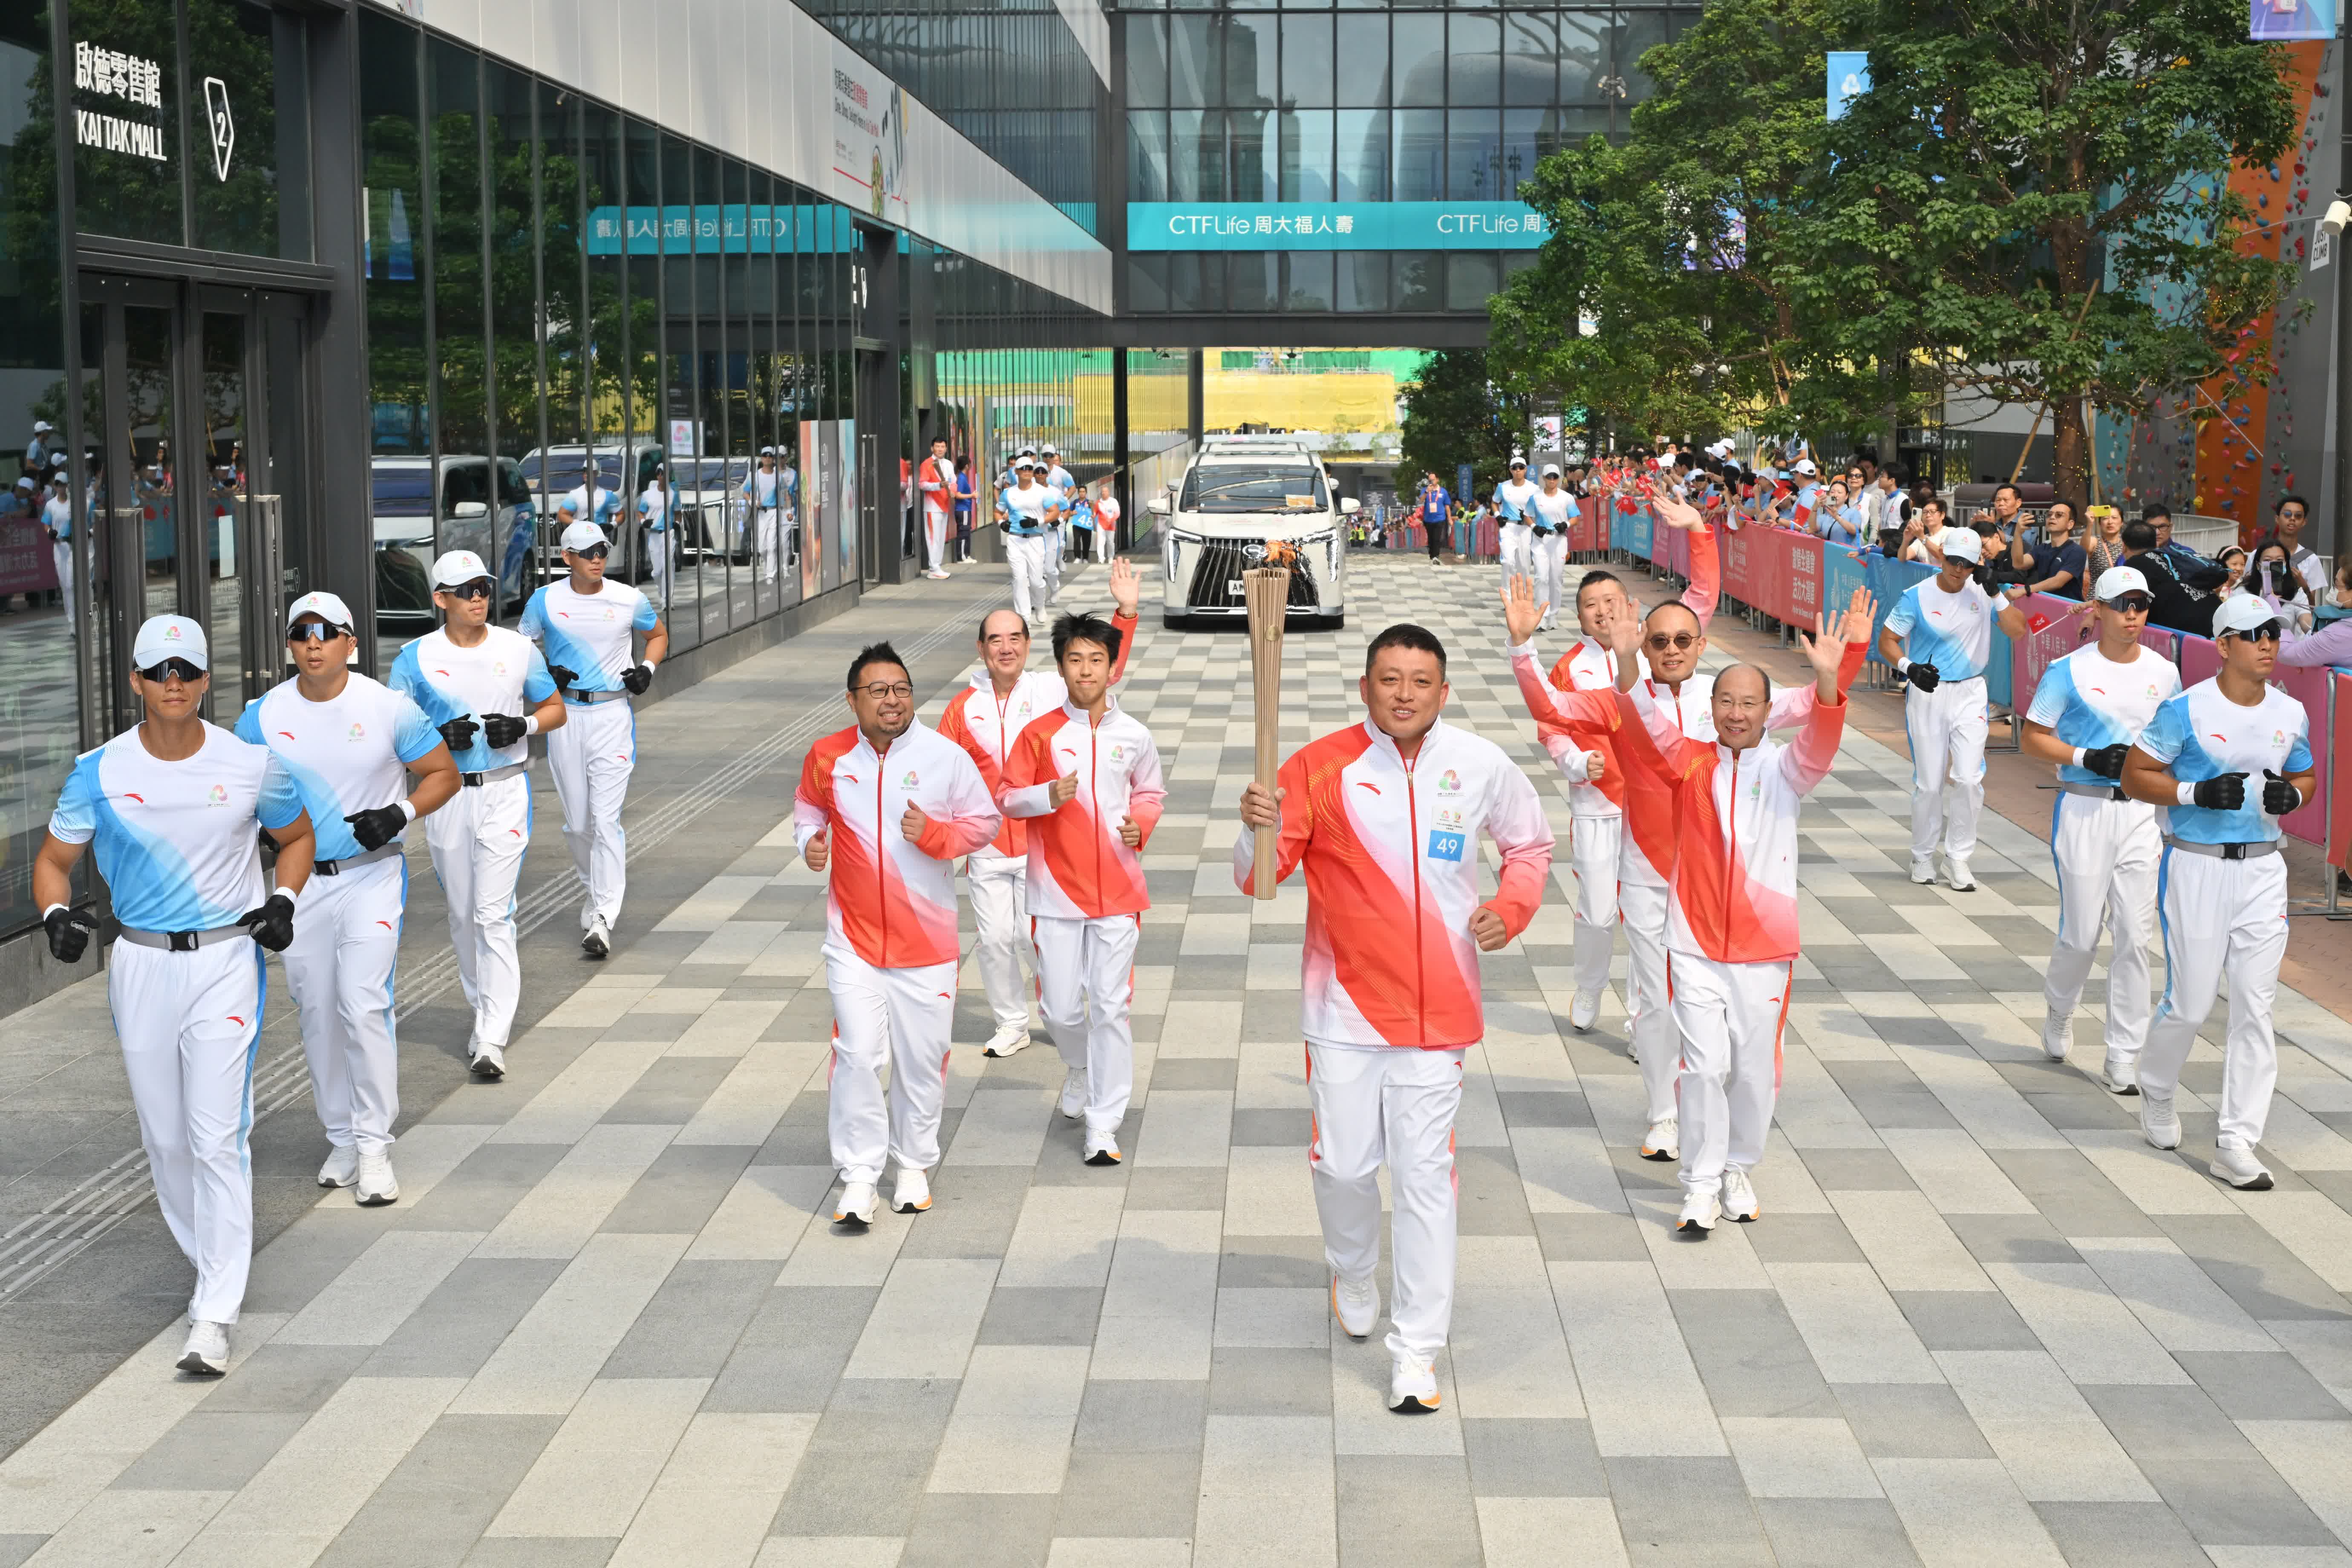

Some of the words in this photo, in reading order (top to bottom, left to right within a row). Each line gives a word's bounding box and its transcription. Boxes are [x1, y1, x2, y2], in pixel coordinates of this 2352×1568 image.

[76, 41, 161, 109] 啟德零售館
[77, 110, 102, 147] KAI
[102, 115, 131, 153] TAK
[130, 122, 167, 161] MALL
[216, 112, 227, 147] 2
[1169, 215, 1250, 234] CTFLife
[1254, 215, 1353, 234] 周大福人壽
[1437, 214, 1518, 233] CTFLife
[2313, 243, 2328, 262] CLIMB
[1077, 514, 1093, 527] 48
[1437, 838, 1458, 854] 49
